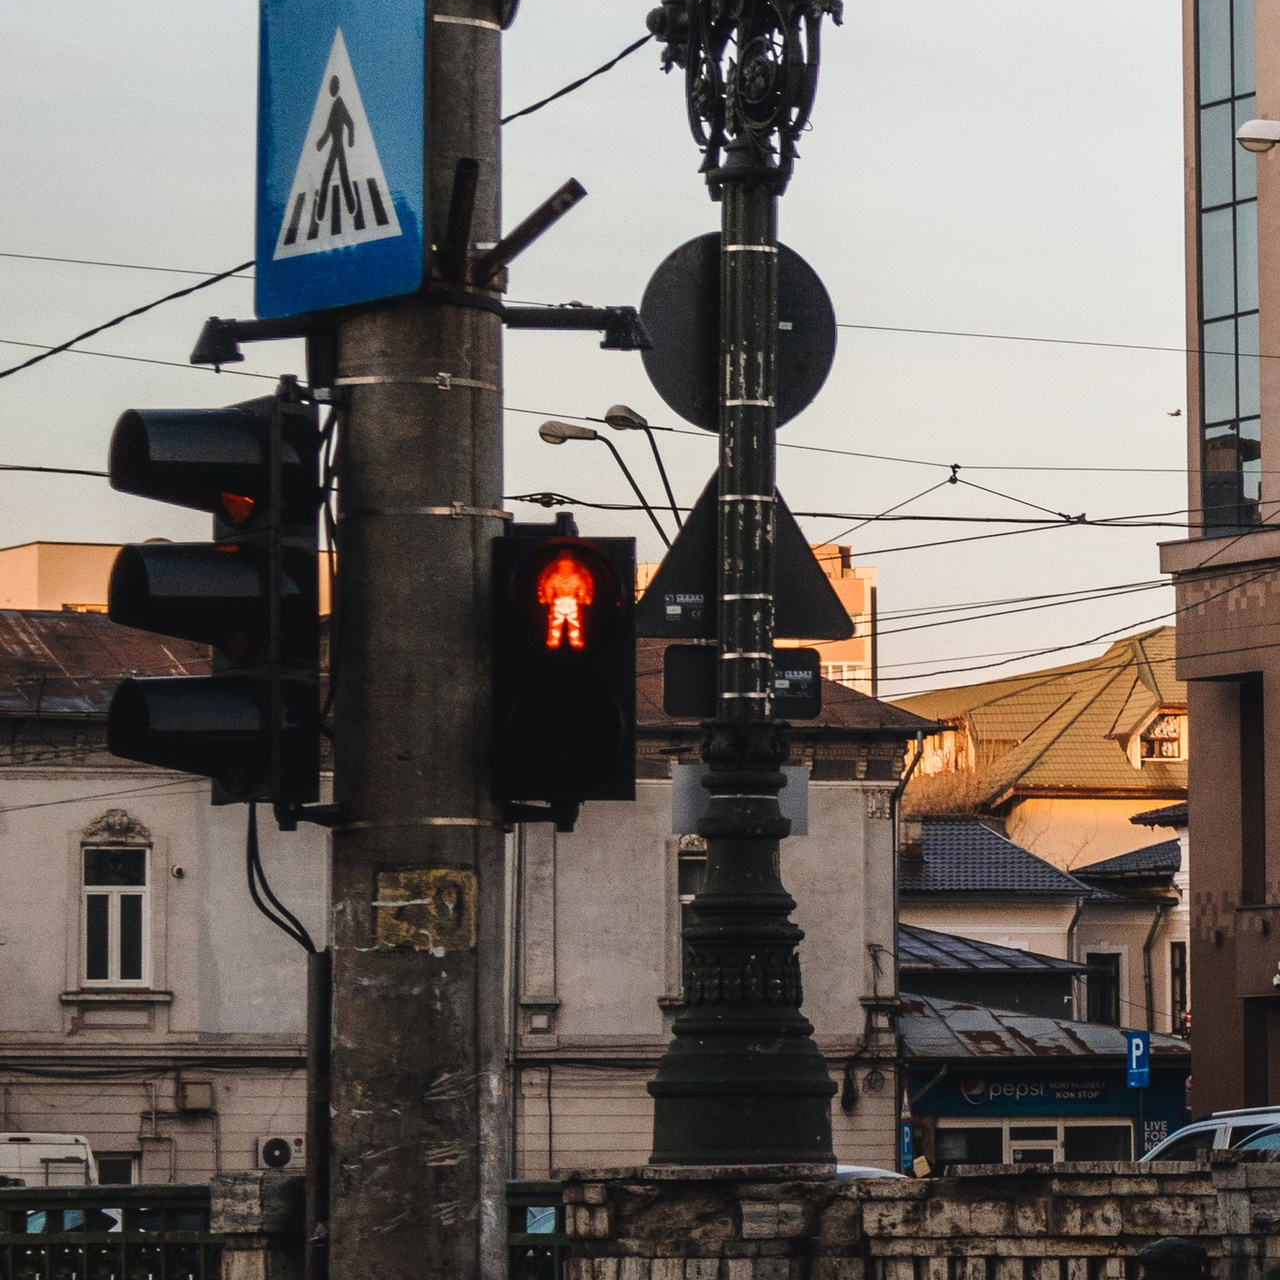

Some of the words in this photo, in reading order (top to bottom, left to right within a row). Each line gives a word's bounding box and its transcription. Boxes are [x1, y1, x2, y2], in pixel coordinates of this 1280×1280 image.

[1131, 1038, 1144, 1069] P
[989, 1079, 1044, 1100] pepsi
[1071, 1080, 1106, 1089] MARKET
[1055, 1091, 1075, 1099] NON
[1077, 1091, 1100, 1099] STOP
[1144, 1121, 1168, 1131] LIVE
[1144, 1131, 1168, 1141] FOR
